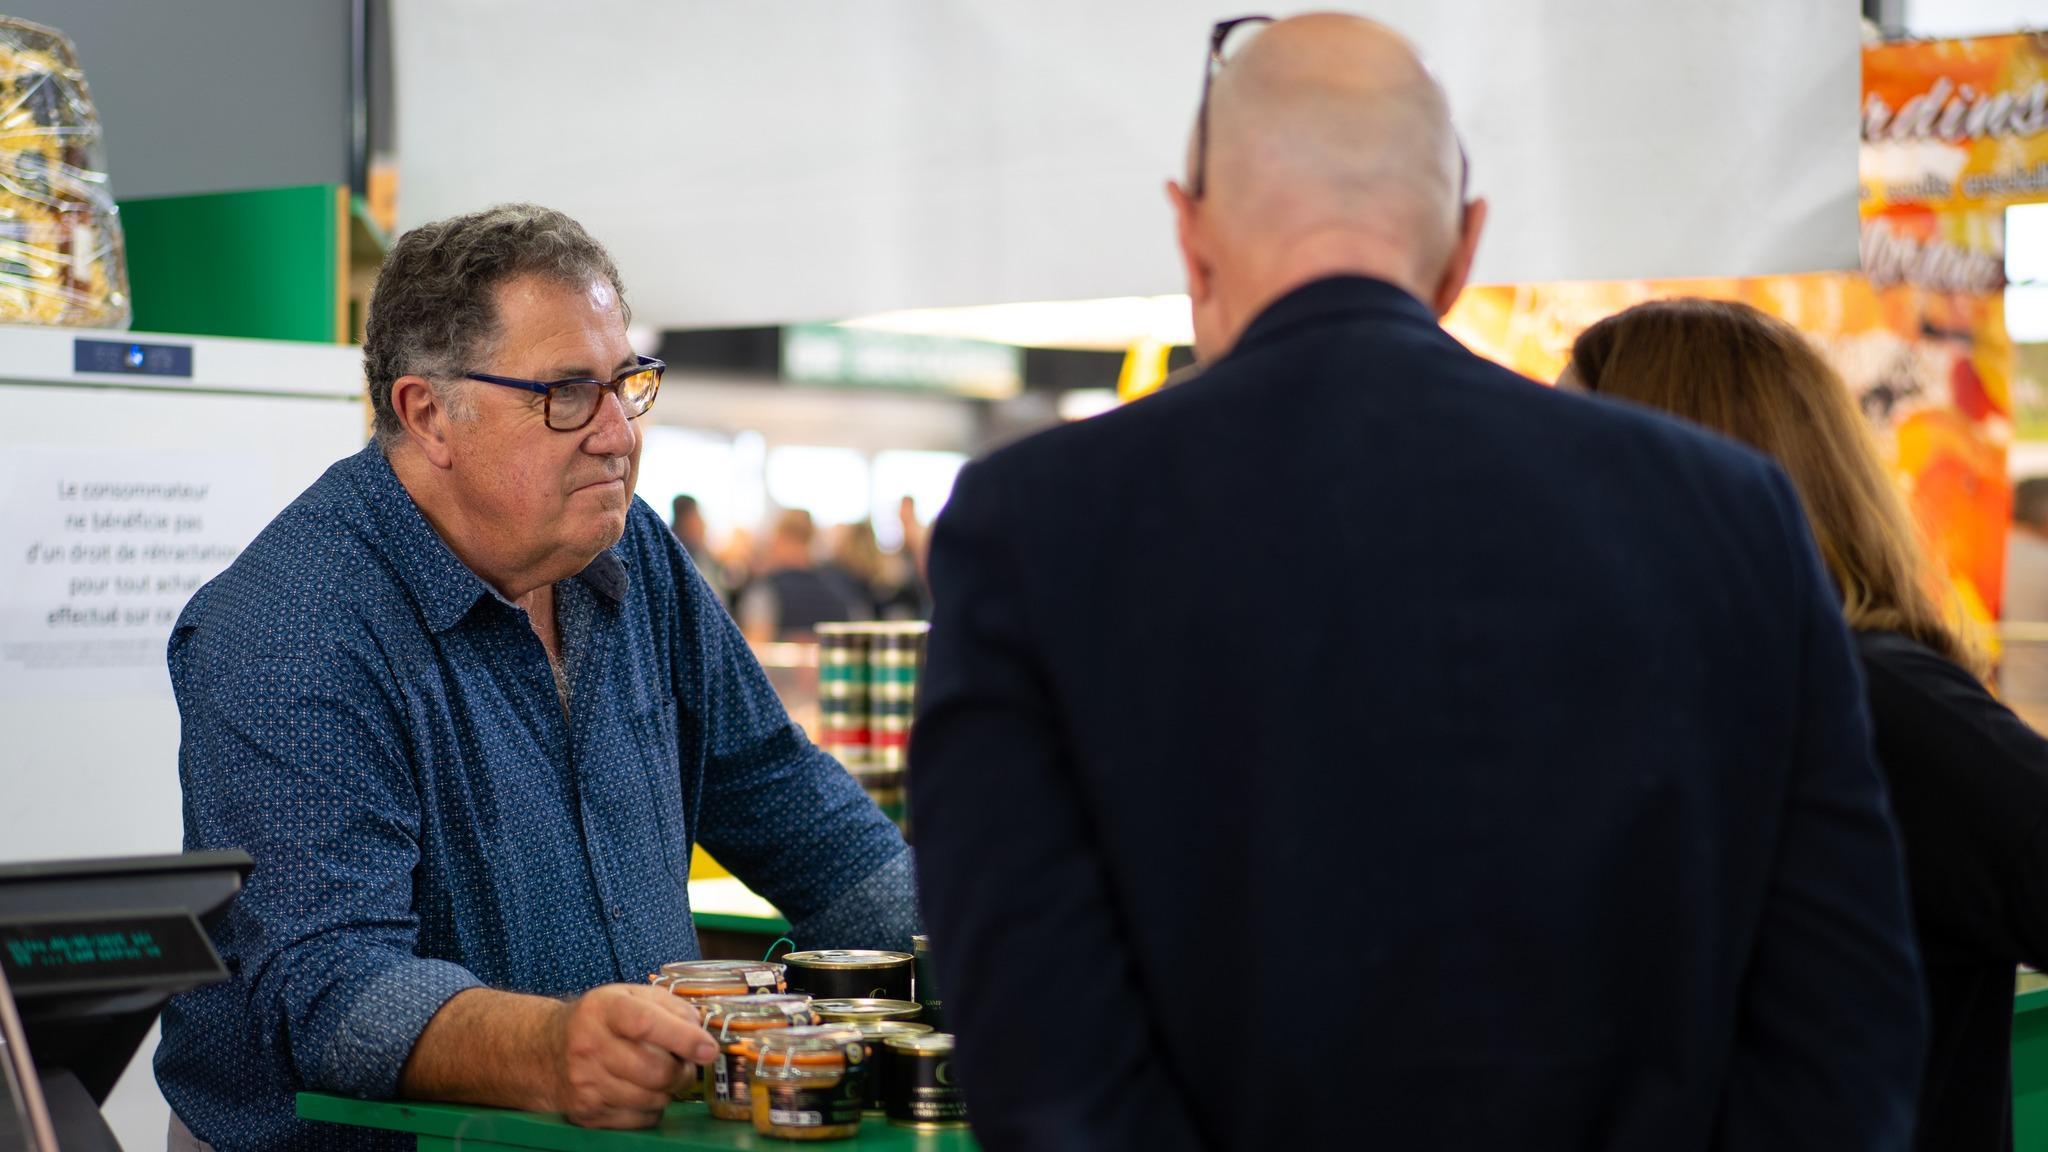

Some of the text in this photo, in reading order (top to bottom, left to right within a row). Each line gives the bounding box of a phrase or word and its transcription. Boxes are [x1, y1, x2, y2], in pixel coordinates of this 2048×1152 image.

[58, 481, 209, 499] Le consommateur
[92, 512, 169, 531] bénéficie
[71, 544, 112, 562] droit
[118, 544, 137, 562] de
[69, 579, 110, 597] pour
[115, 577, 151, 593] tout
[48, 607, 119, 628] effectué
[125, 611, 151, 625] sur
